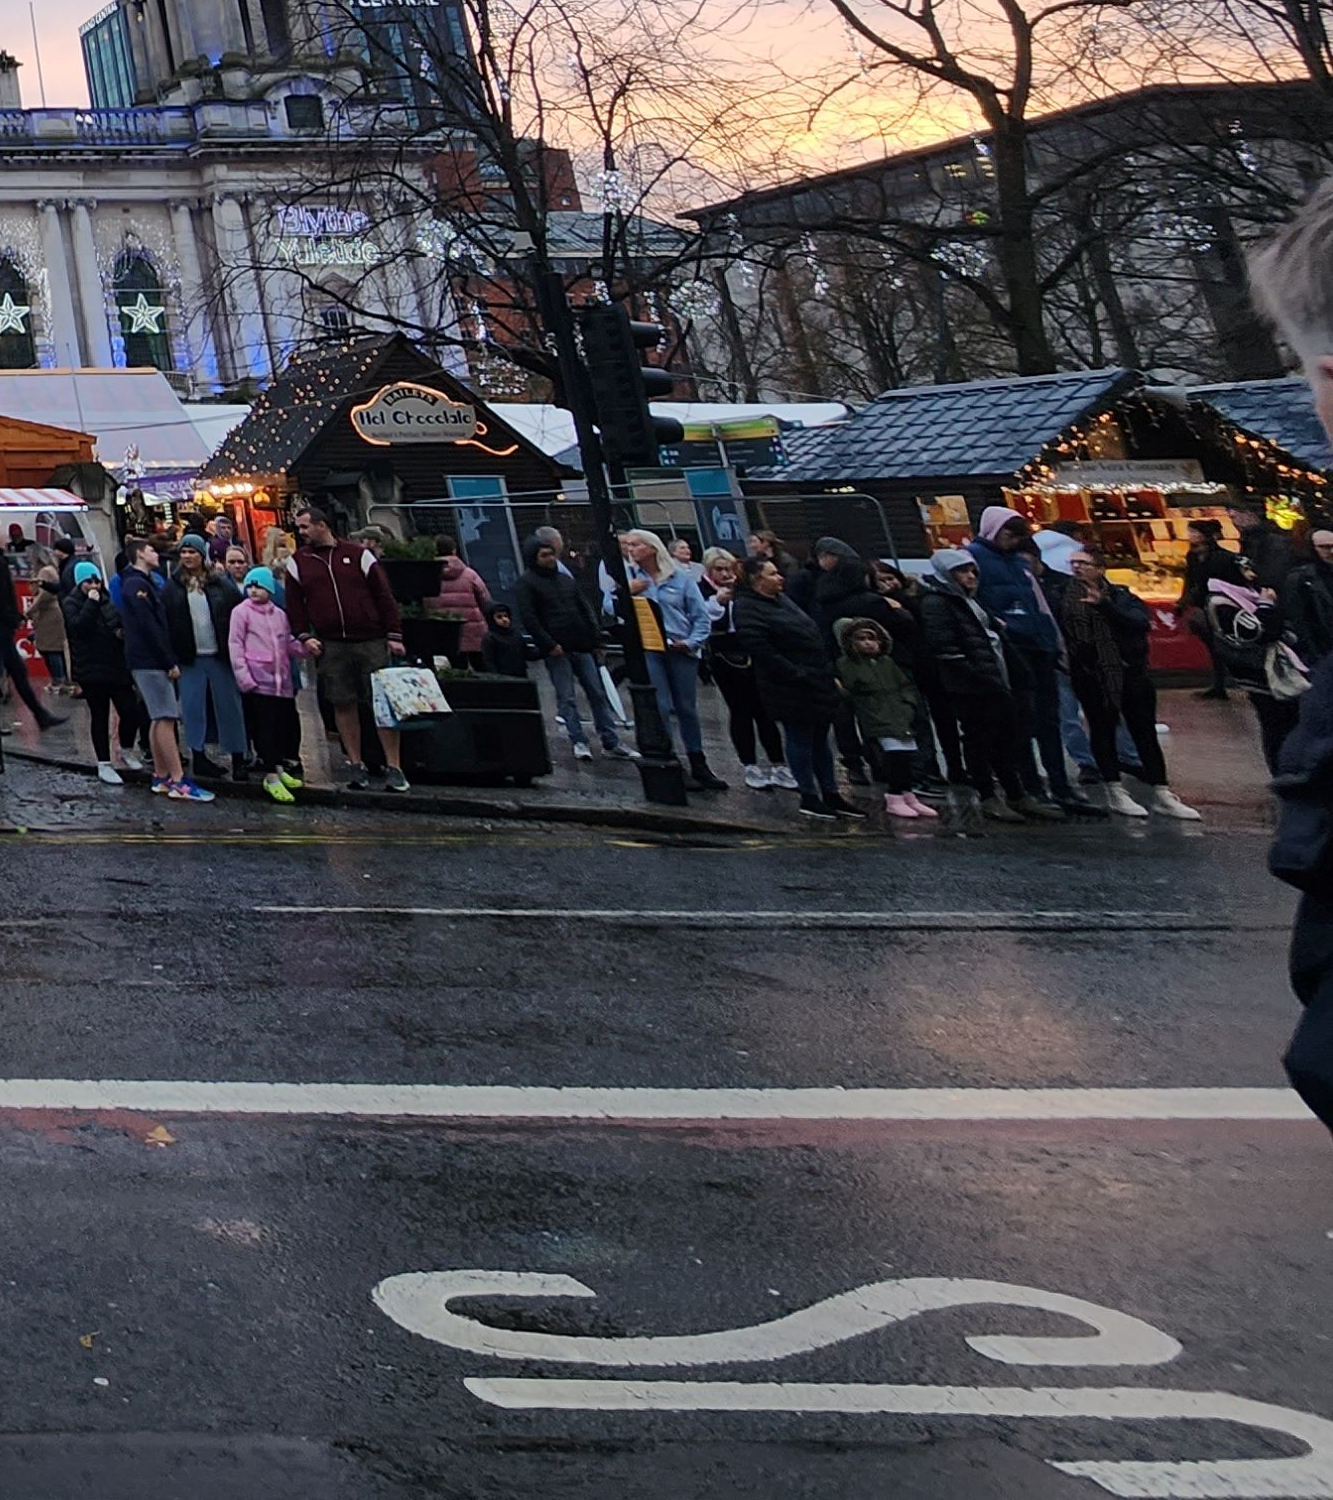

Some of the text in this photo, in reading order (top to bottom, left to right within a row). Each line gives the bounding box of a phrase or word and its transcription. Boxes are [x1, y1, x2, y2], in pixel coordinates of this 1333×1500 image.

[277, 205, 369, 238] Blythe
[277, 237, 381, 265] Yuletide
[386, 389, 436, 404] BAILEYS
[359, 410, 473, 425] Hot Chocolate
